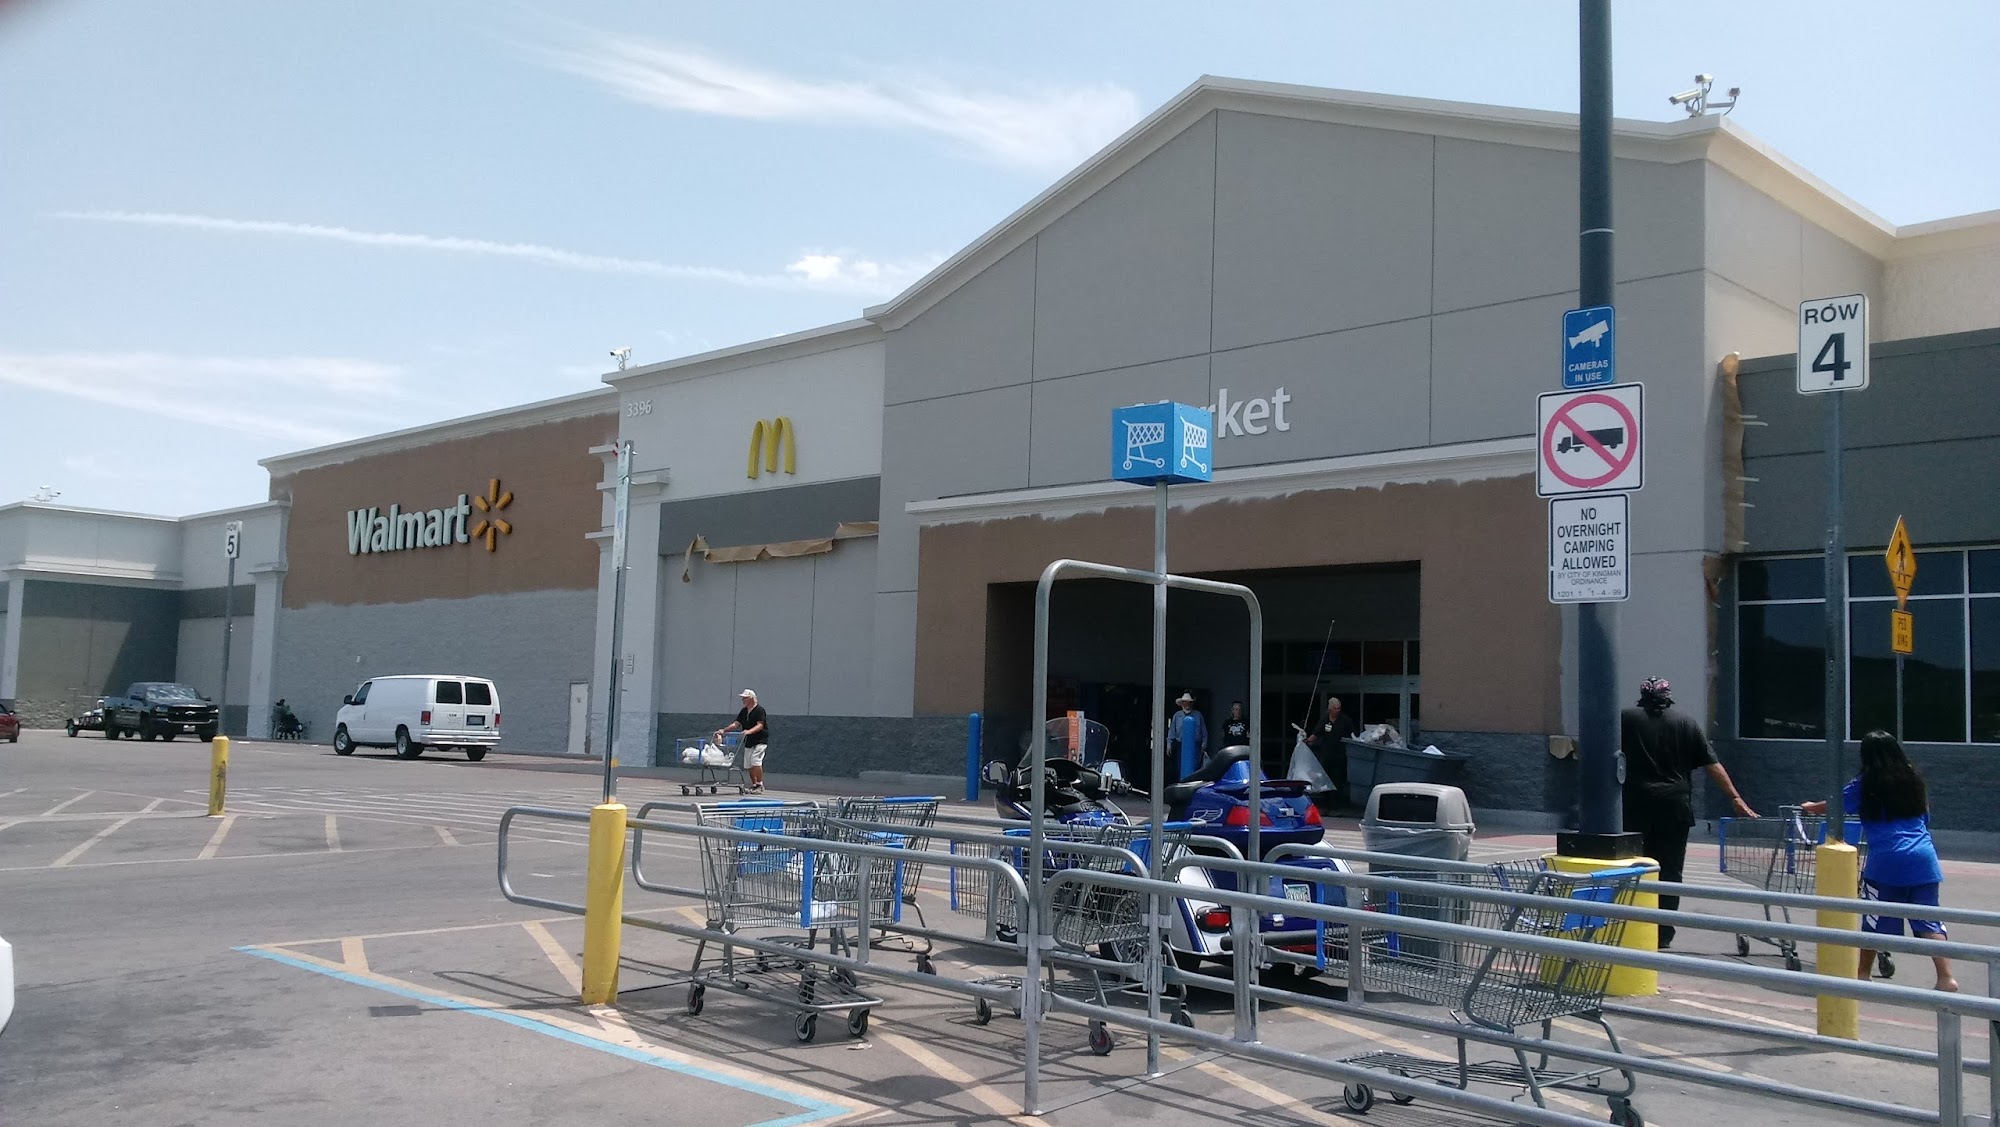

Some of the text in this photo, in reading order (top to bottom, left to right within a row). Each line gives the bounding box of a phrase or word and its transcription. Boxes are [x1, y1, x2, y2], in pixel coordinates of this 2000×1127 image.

[1804, 303, 1859, 325] ROW
[1811, 332, 1851, 382] 4
[1568, 359, 1609, 372] CAMERAS
[1574, 371, 1602, 382] IN USE
[626, 400, 652, 418] 3396
[1580, 507, 1597, 521] NO
[347, 493, 471, 556] Walmart
[1557, 522, 1622, 538] OVERNIGHT
[227, 535, 235, 555] 5
[1563, 539, 1615, 554] CAMPING
[1561, 555, 1617, 570] ALLOWED
[1567, 571, 1581, 579] CITY
[1592, 569, 1622, 577] KINGMAN
[1571, 577, 1608, 585] ORDINANCE
